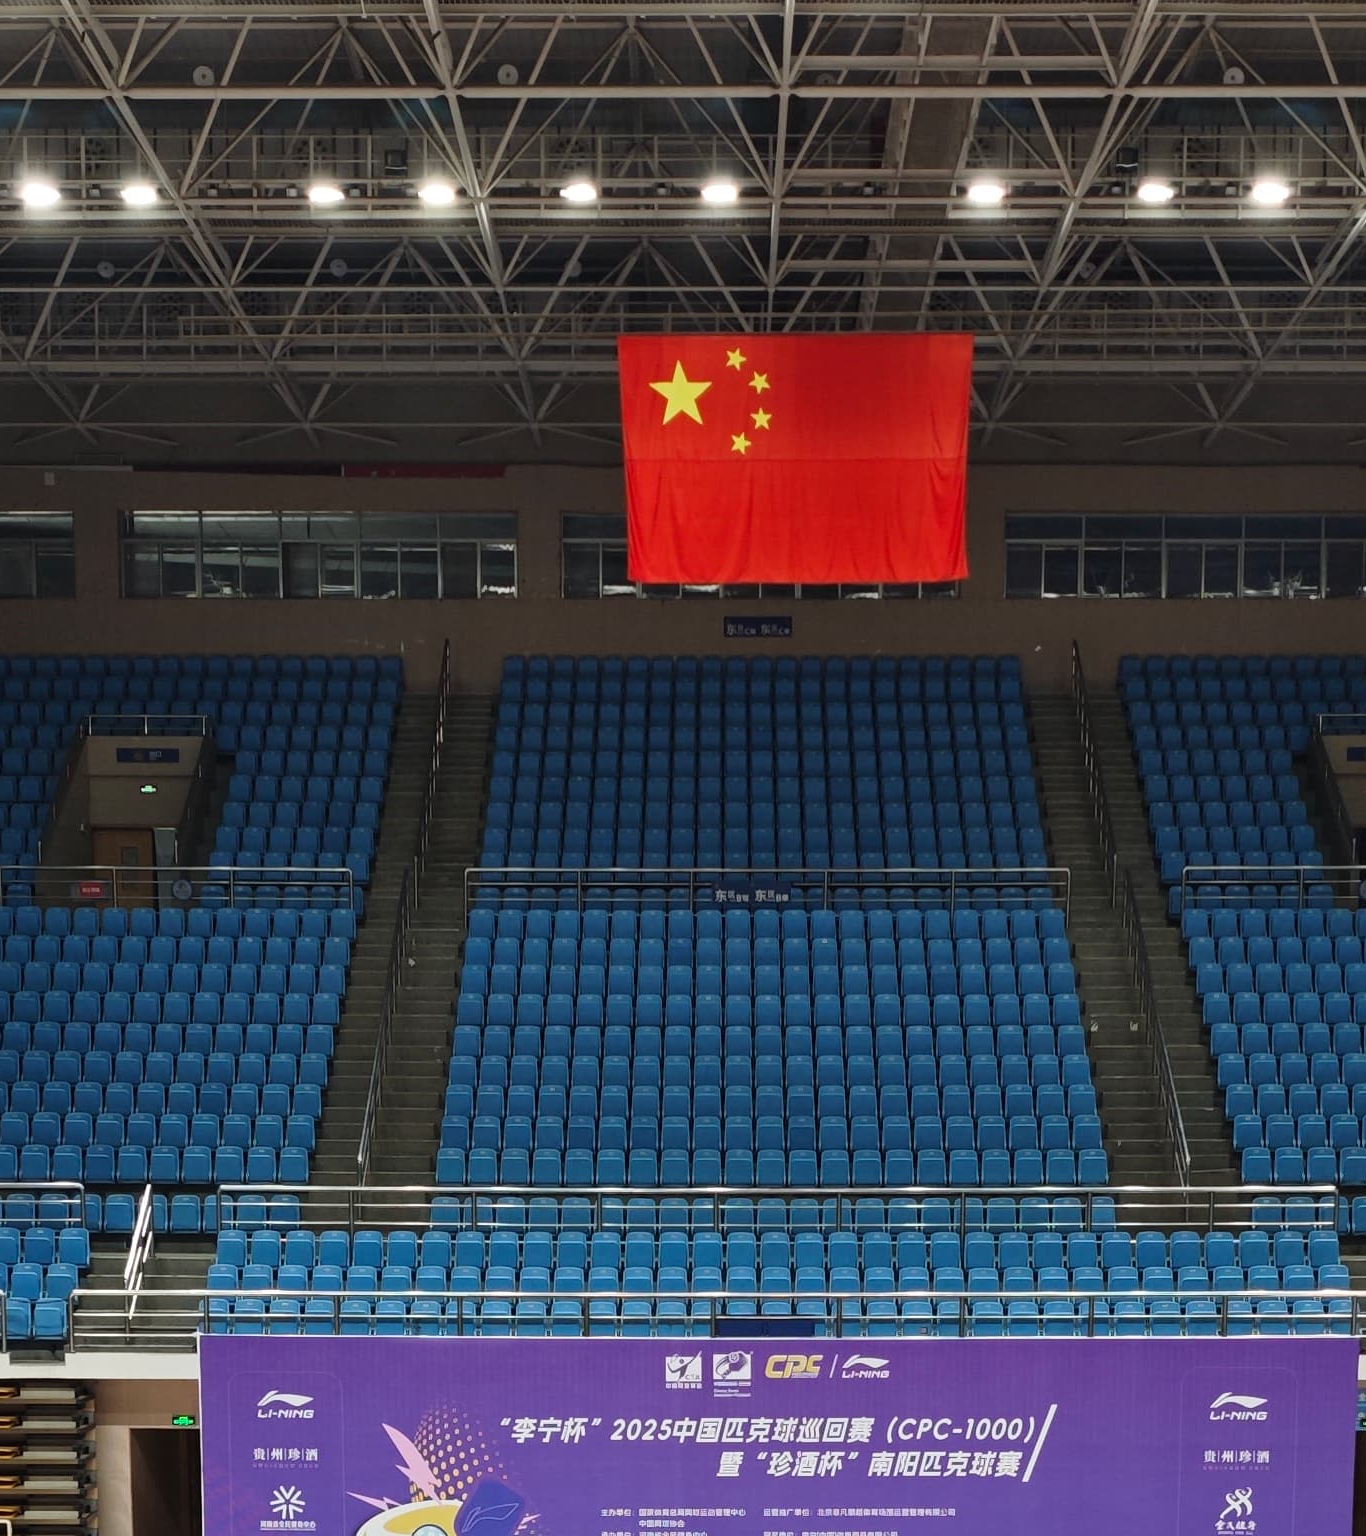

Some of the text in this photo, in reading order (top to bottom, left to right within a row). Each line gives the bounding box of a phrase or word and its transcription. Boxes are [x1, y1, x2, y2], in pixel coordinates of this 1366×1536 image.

[765, 1354, 824, 1378] CPC
[841, 1370, 890, 1379] LI-NING
[257, 1408, 315, 1419] LI-NING
[1209, 1410, 1268, 1421] LI-NING
